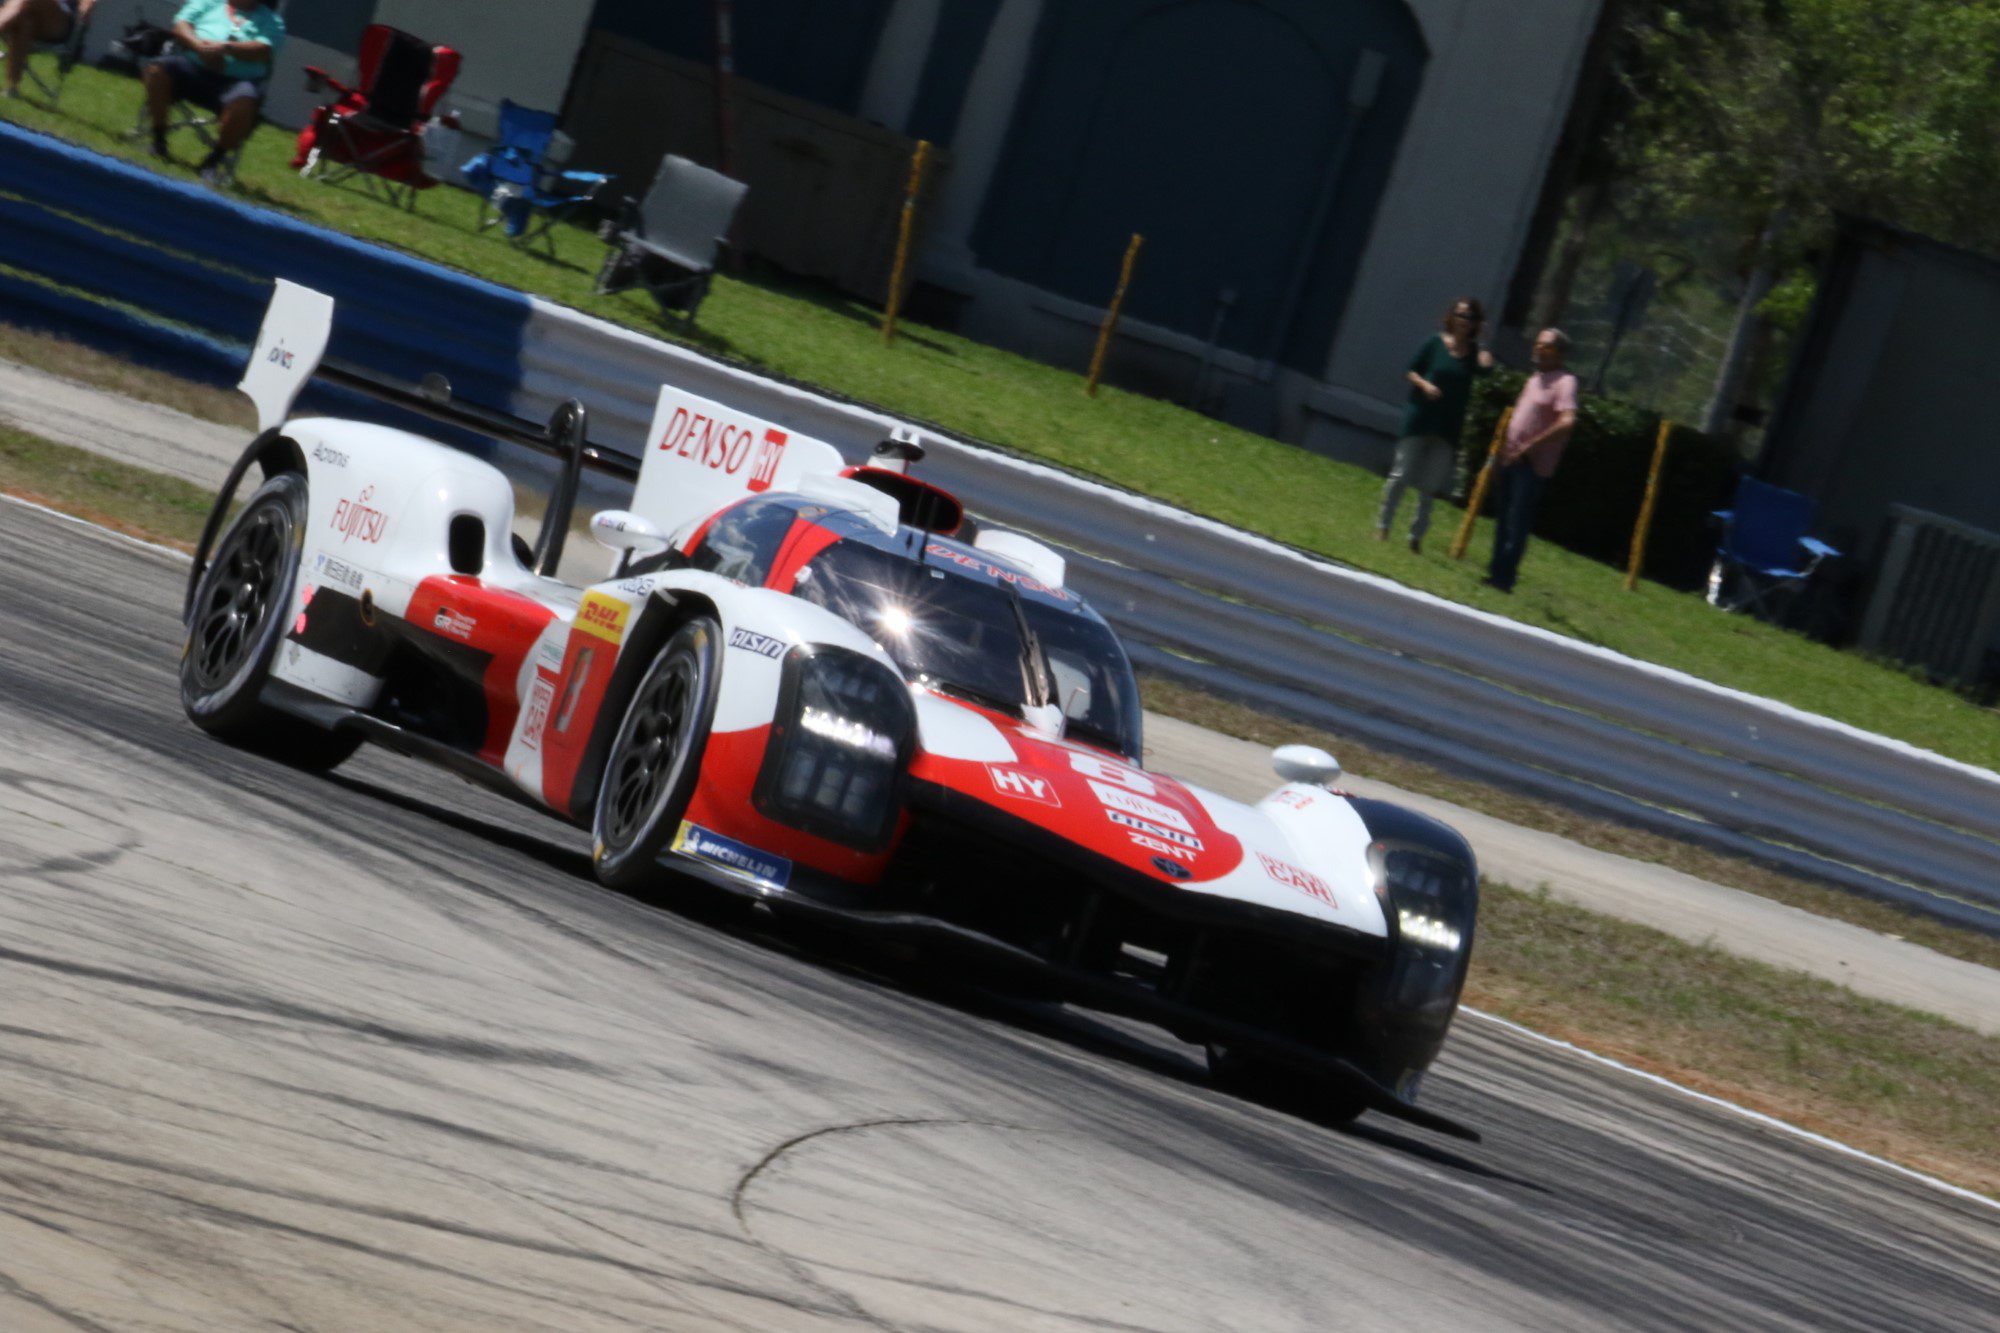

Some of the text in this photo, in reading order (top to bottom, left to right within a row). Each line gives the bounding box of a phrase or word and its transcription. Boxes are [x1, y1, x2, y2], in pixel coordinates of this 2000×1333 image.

[659, 406, 753, 475] DENSO
[330, 498, 389, 545] FUJITSU
[925, 544, 1068, 601] DENSO
[729, 627, 786, 660] AISIN
[990, 767, 1049, 799] HY
[1104, 808, 1206, 852] AISIN
[1127, 830, 1198, 863] ZENT
[699, 841, 779, 879] MICHELIN
[1268, 865, 1332, 902] CAR
